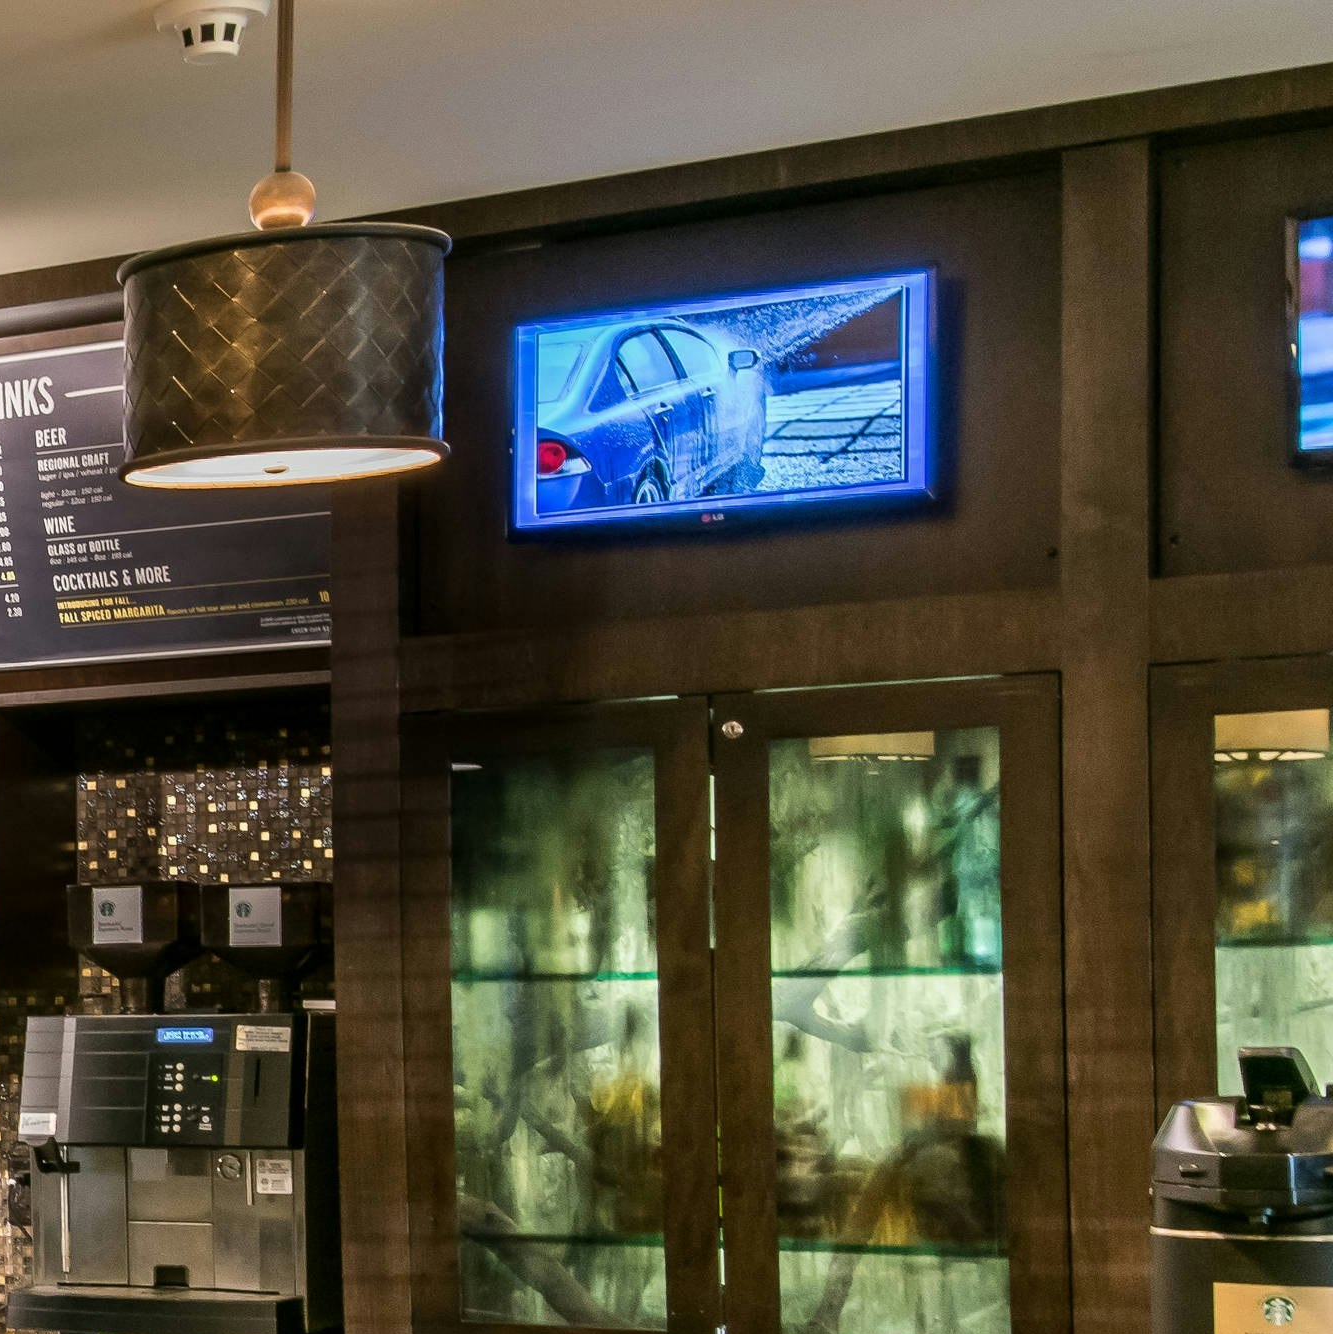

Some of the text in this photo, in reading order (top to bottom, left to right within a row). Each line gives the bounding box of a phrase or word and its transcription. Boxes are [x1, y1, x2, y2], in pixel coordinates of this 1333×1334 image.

[35, 427, 66, 447] BEER
[37, 452, 108, 471] REGIONAL CRAFT
[44, 516, 75, 534] WINE
[47, 538, 120, 556] GLASS or BOTTLE
[53, 566, 169, 591] COCKTAILS & MORE
[59, 605, 164, 623] FALL SPICED MARGARITA
